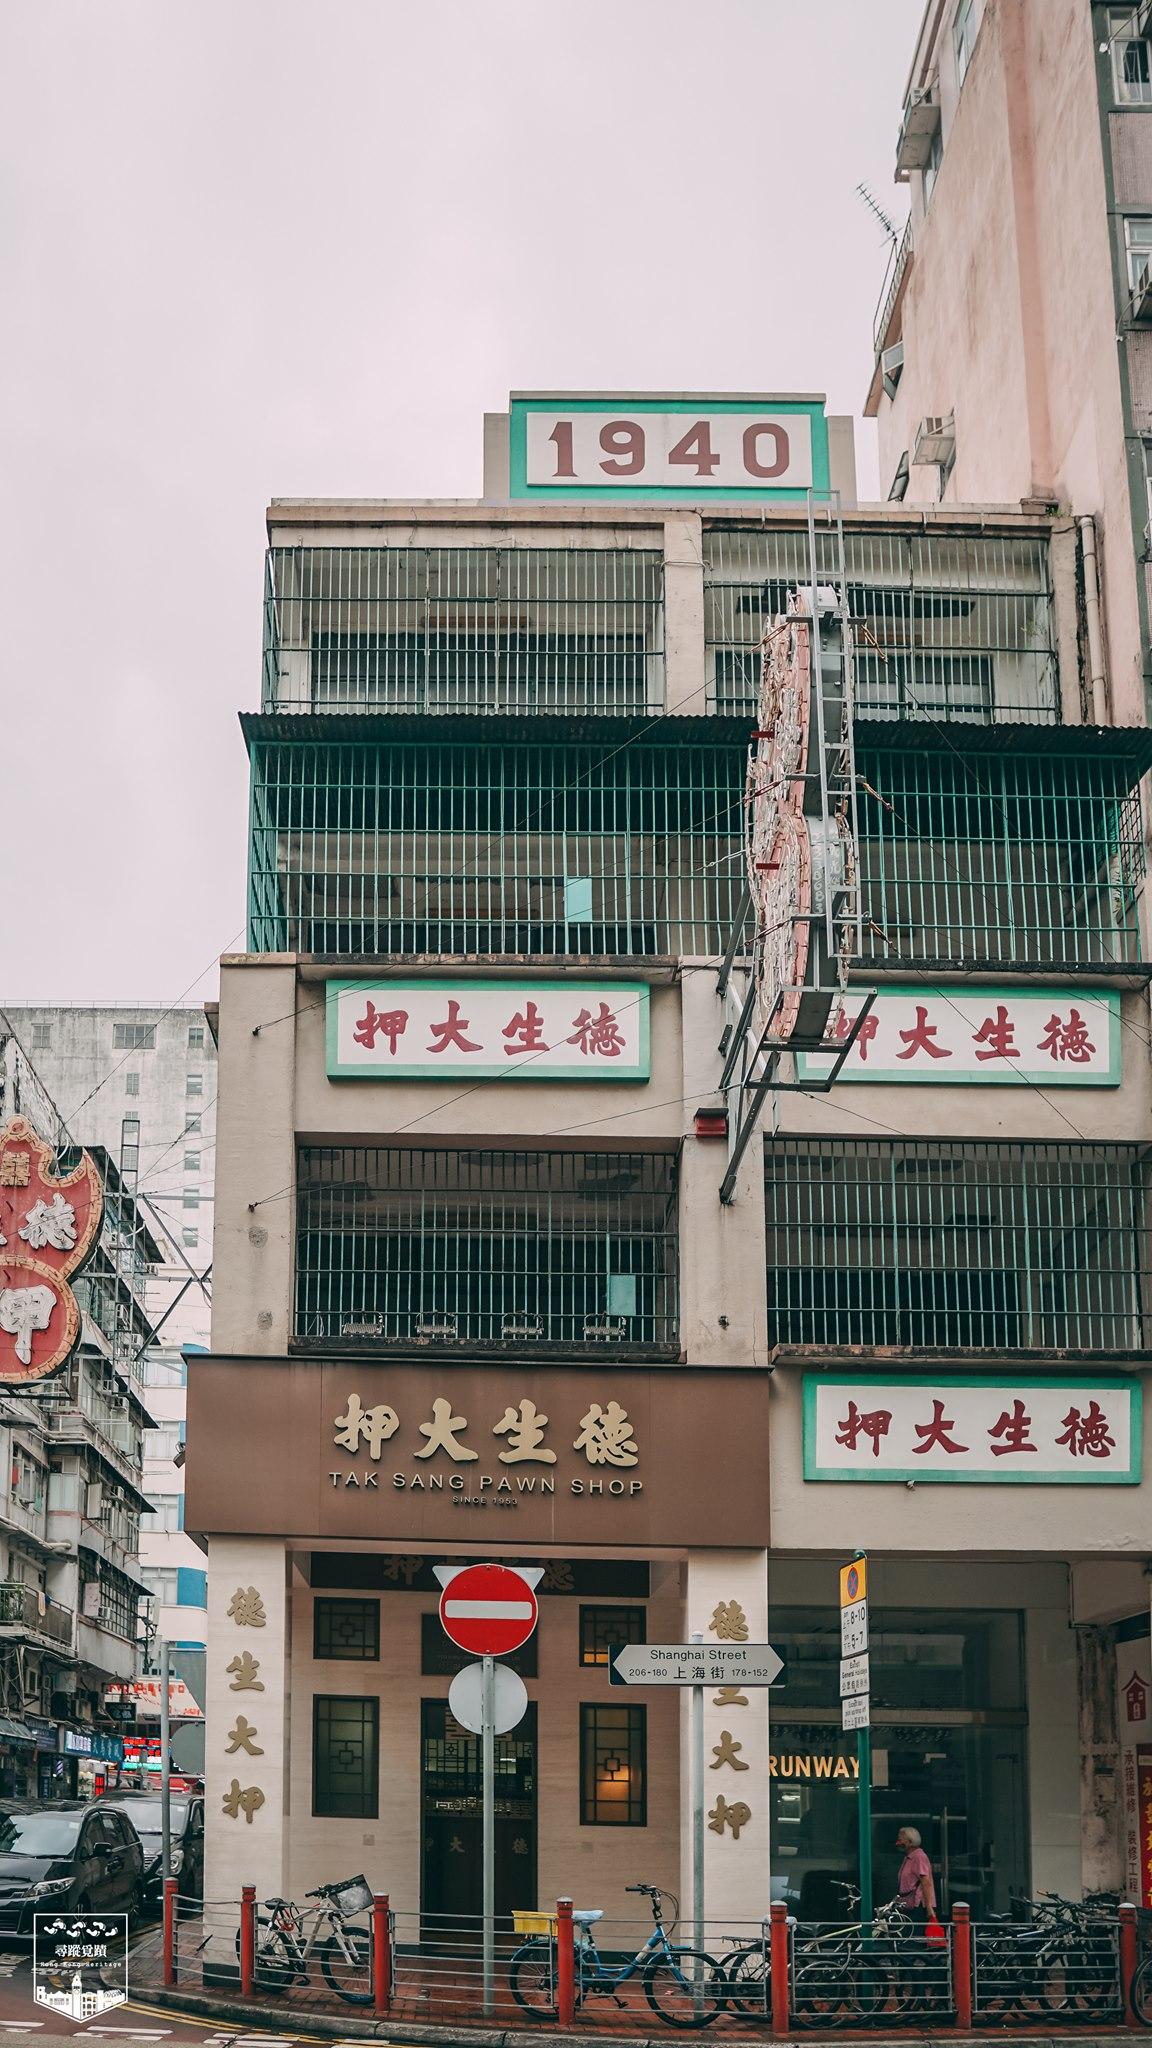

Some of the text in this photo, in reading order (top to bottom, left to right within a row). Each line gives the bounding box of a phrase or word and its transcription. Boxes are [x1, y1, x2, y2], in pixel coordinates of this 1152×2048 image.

[547, 420, 791, 478] 1940
[329, 1472, 644, 1496] TAK SANG PAWN SHOP
[452, 1495, 487, 1505] SINCE
[850, 1606, 866, 1625] 8-10
[650, 1649, 747, 1662] Shanghai Street
[629, 1666, 769, 1680] 206-180 上海街 178-152
[222, 1586, 267, 1824] 德生大押
[768, 1754, 860, 1779] RUNWAY
